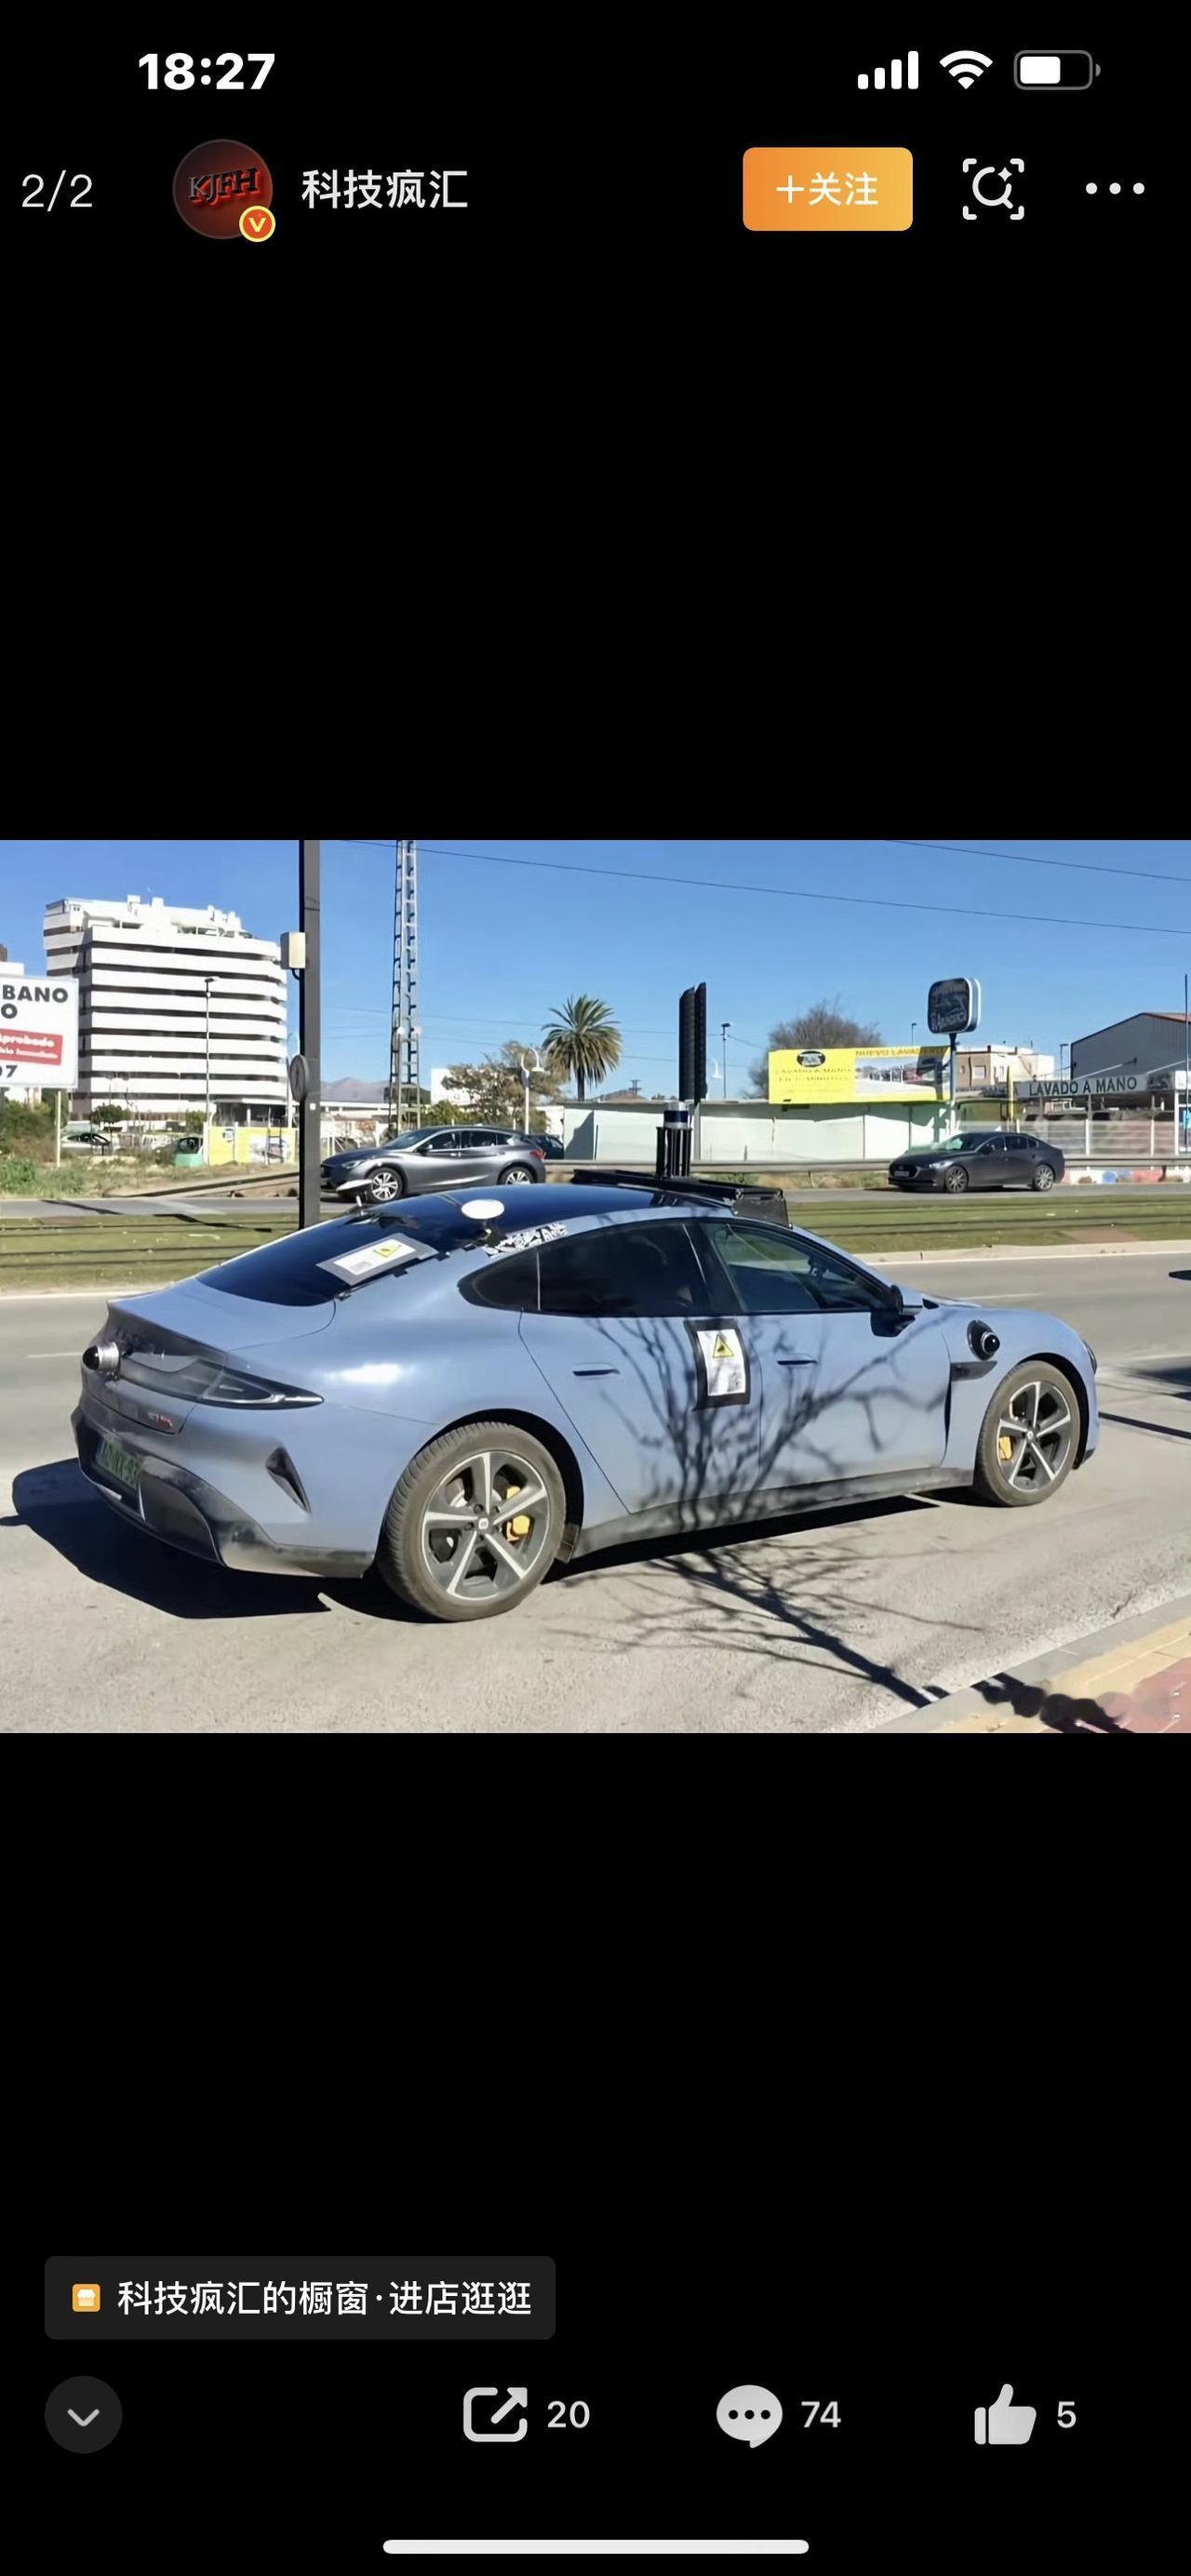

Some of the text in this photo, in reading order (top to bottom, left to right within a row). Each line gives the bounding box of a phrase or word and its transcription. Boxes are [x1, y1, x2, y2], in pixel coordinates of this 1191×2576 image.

[1029, 1081, 1078, 1096] LAVADO
[1083, 1083, 1091, 1093] A
[1096, 1076, 1137, 1092] MANO
